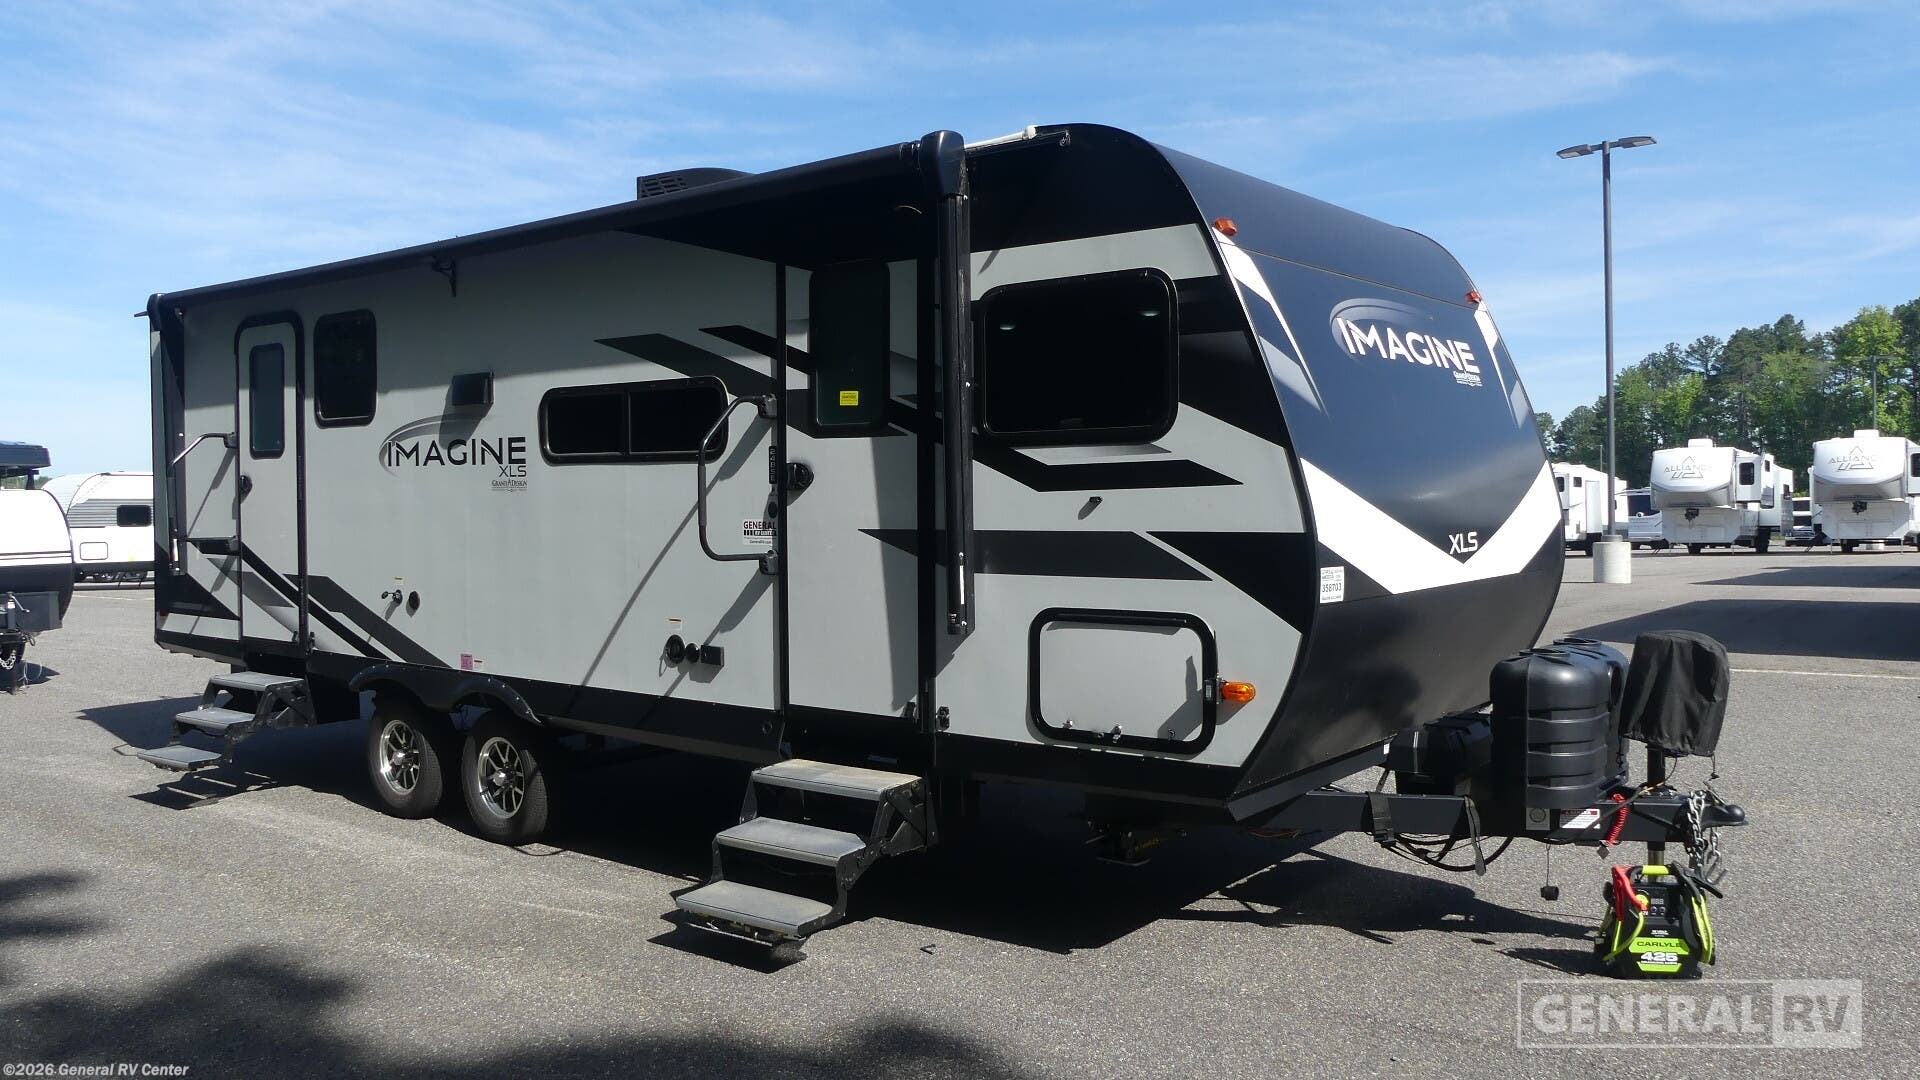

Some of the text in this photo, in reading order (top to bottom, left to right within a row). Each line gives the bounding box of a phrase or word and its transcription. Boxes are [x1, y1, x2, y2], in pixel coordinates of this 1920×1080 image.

[1336, 317, 1481, 374] IMAGINE
[387, 436, 527, 467] IMAGINE
[499, 465, 527, 477] XLS
[743, 521, 776, 530] GENERAL
[1448, 531, 1479, 555] XLS
[1321, 583, 1342, 593] 358703
[1640, 951, 1678, 962] 425
